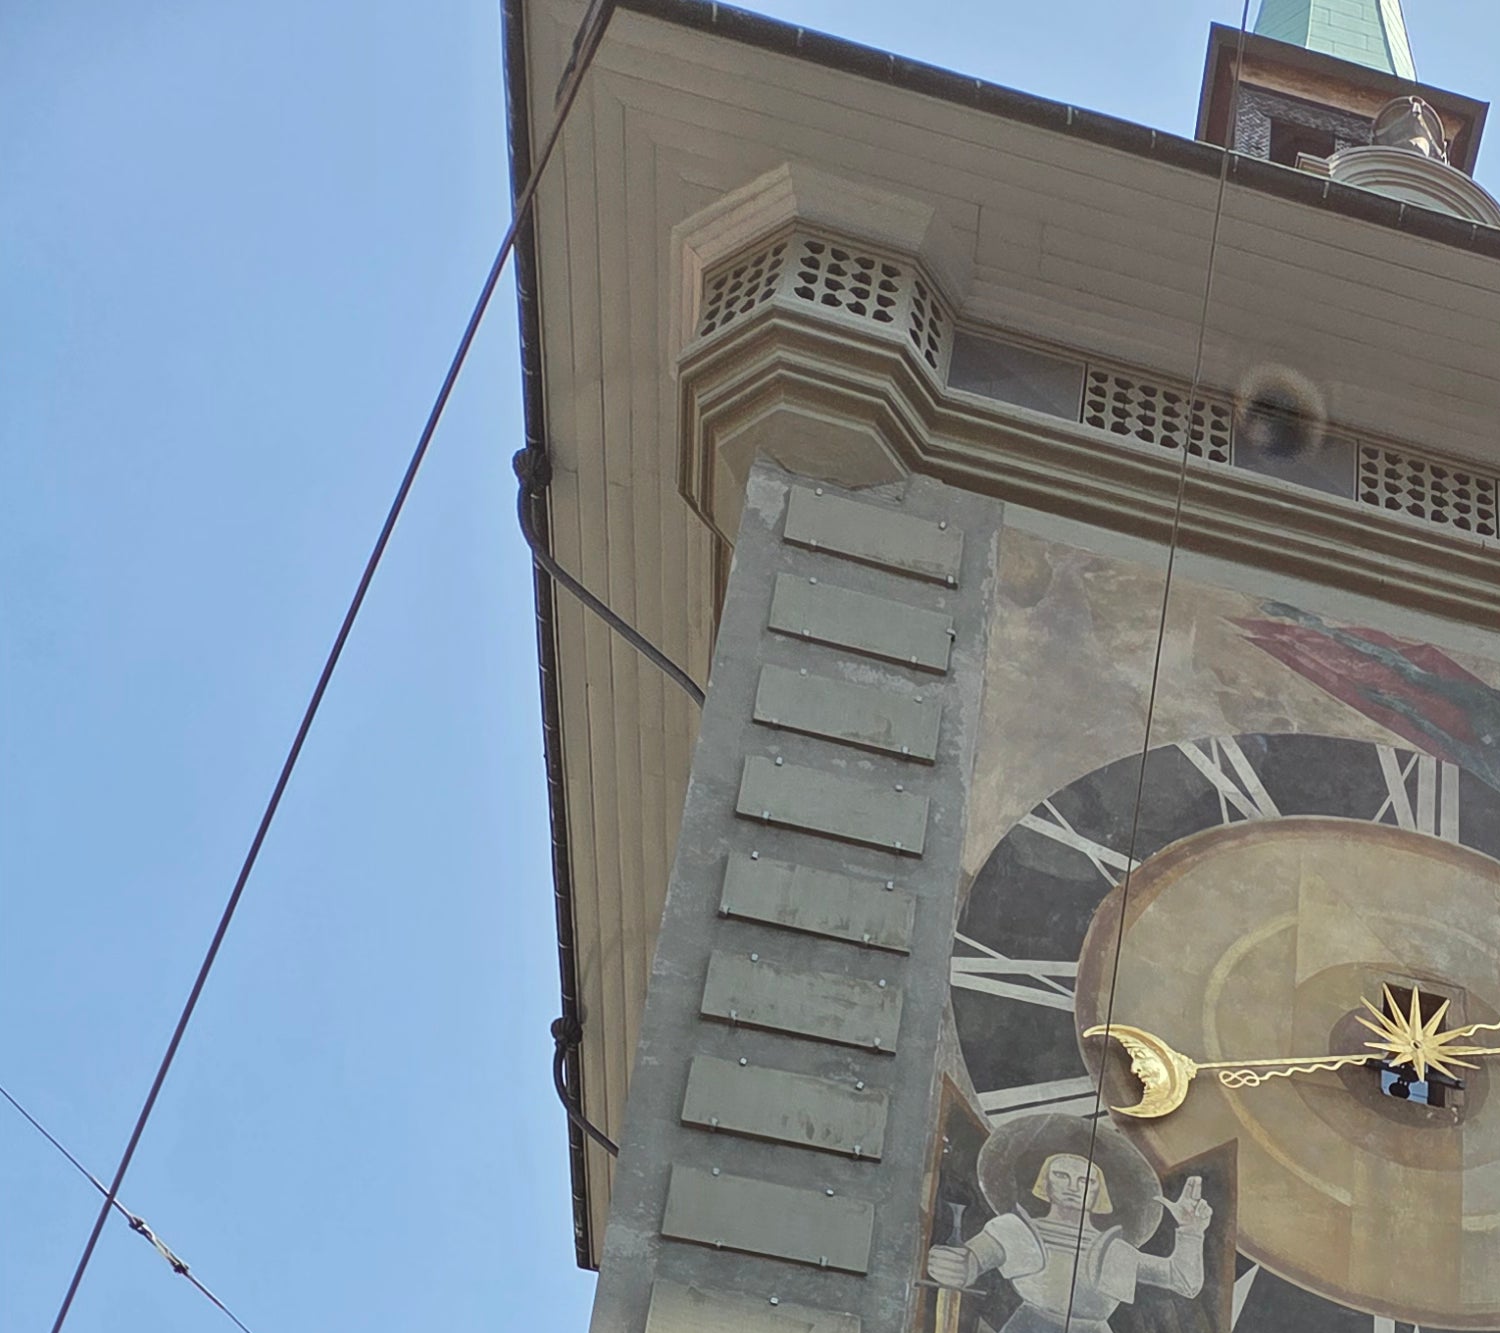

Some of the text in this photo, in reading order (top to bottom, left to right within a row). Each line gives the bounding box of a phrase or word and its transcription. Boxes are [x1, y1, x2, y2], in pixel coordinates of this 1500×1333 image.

[1176, 733, 1283, 822] XI
[1375, 744, 1461, 840] XII
[1017, 797, 1144, 880] X
[948, 930, 1077, 1010] IX
